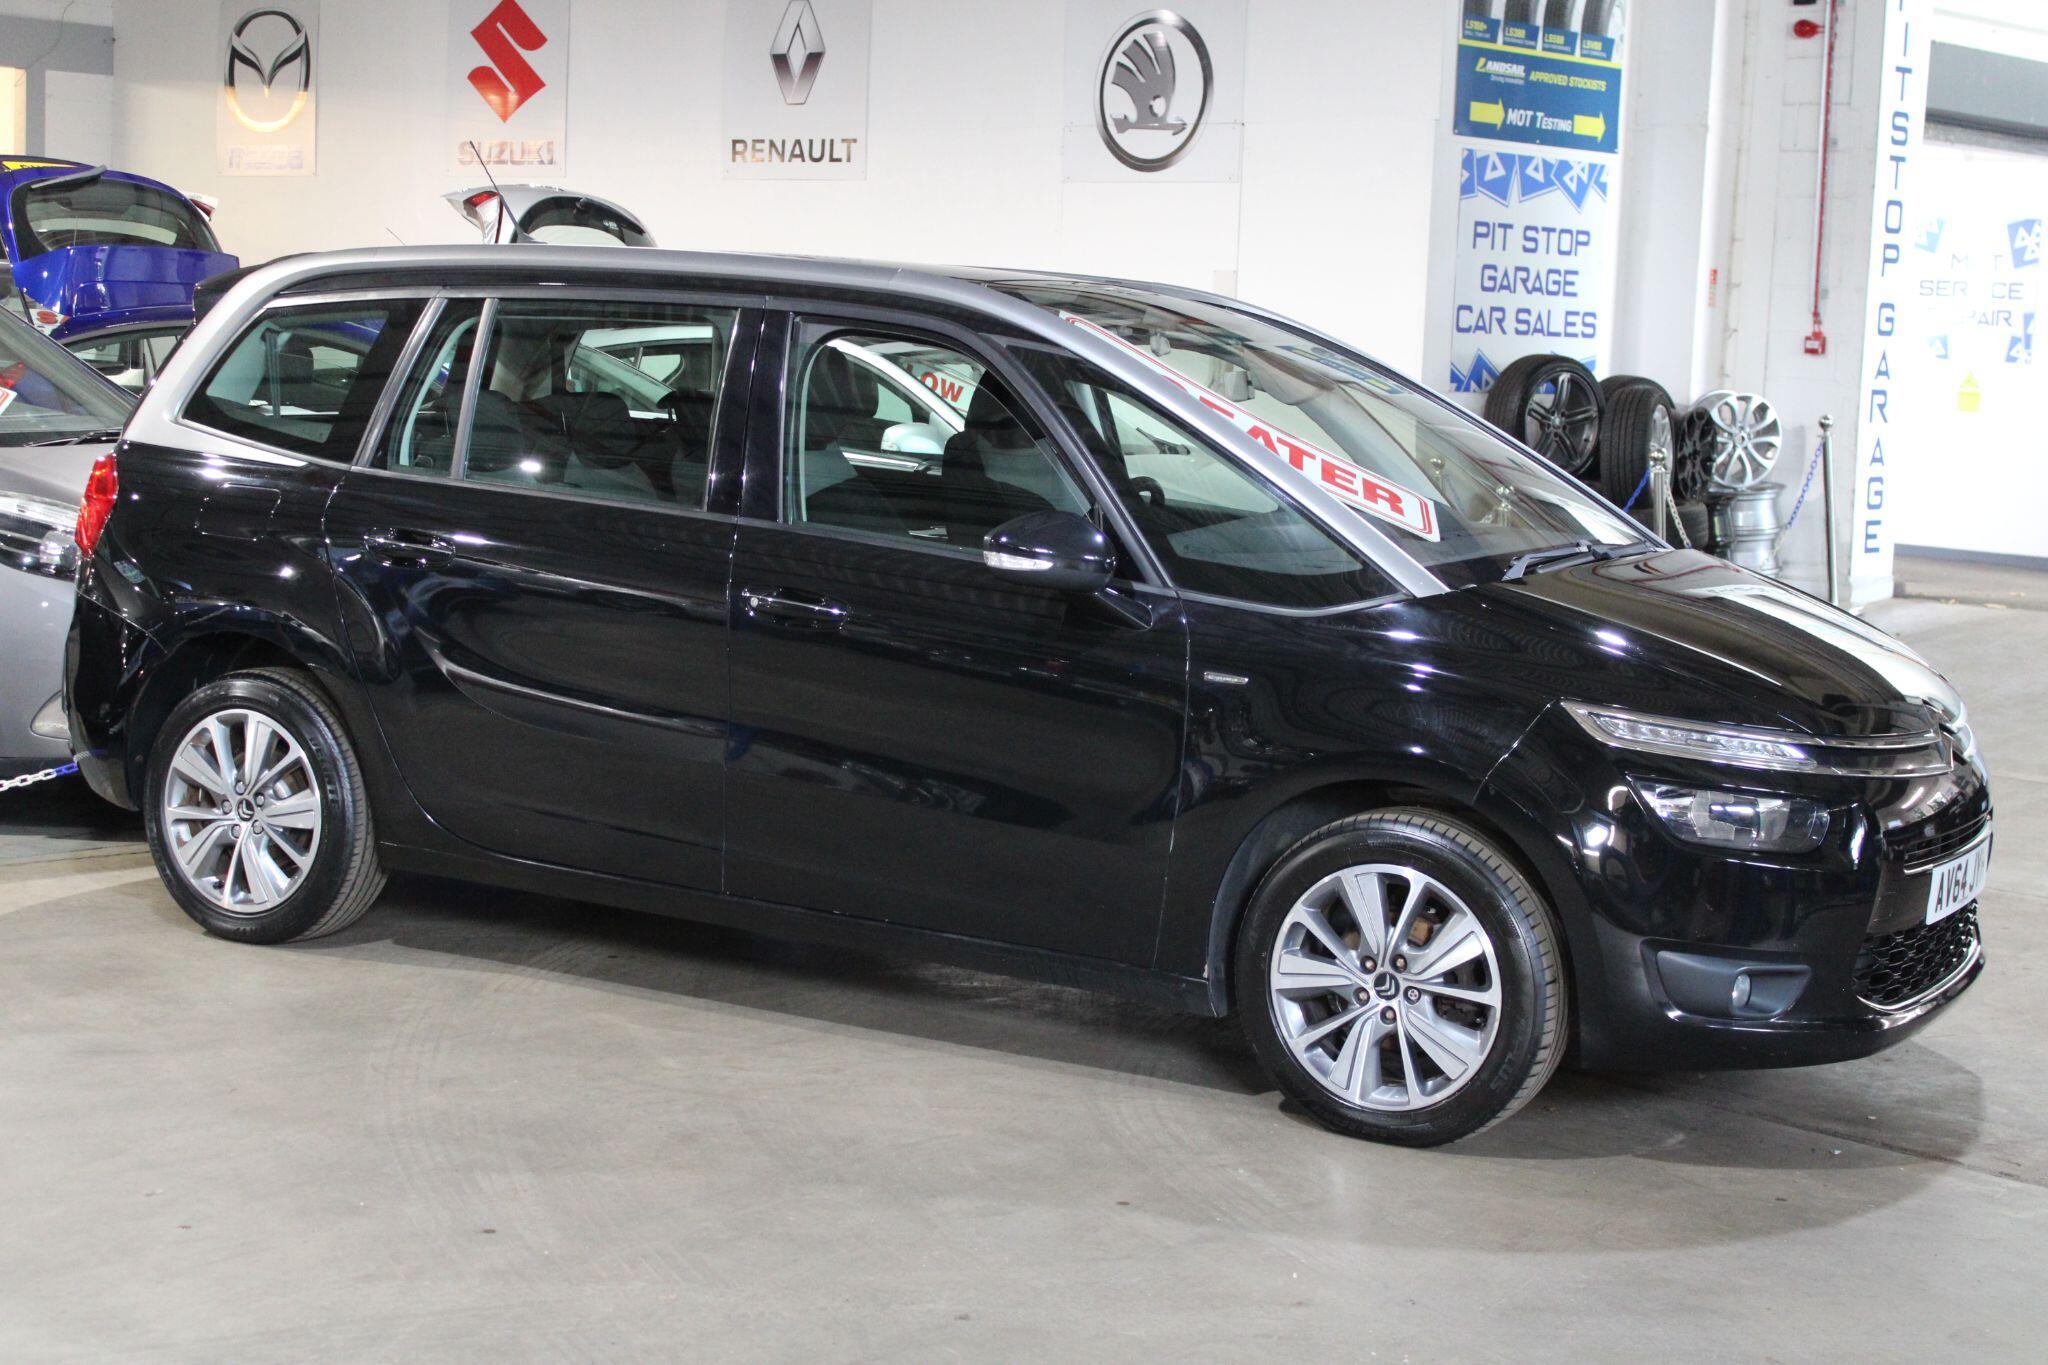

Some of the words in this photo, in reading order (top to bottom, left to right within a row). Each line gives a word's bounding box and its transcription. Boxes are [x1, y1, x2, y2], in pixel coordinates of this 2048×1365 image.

[1894, 0, 1912, 101] IT
[1529, 71, 1569, 86] APPROVED
[1569, 76, 1607, 92] STOCKISTS
[1506, 108, 1534, 127] MOT
[458, 140, 554, 166] SUZUKI
[731, 138, 857, 164] RENAULT
[1881, 111, 1910, 278] STOP
[1472, 220, 1514, 251] PIT
[1522, 225, 1590, 256] STOP
[1480, 264, 1579, 297] GARAGE
[1455, 304, 1508, 335] CAR
[1514, 307, 1598, 339] SALES
[906, 363, 964, 403] OW
[1864, 302, 1896, 553] GARAGE
[1934, 858, 1969, 914] AV64
